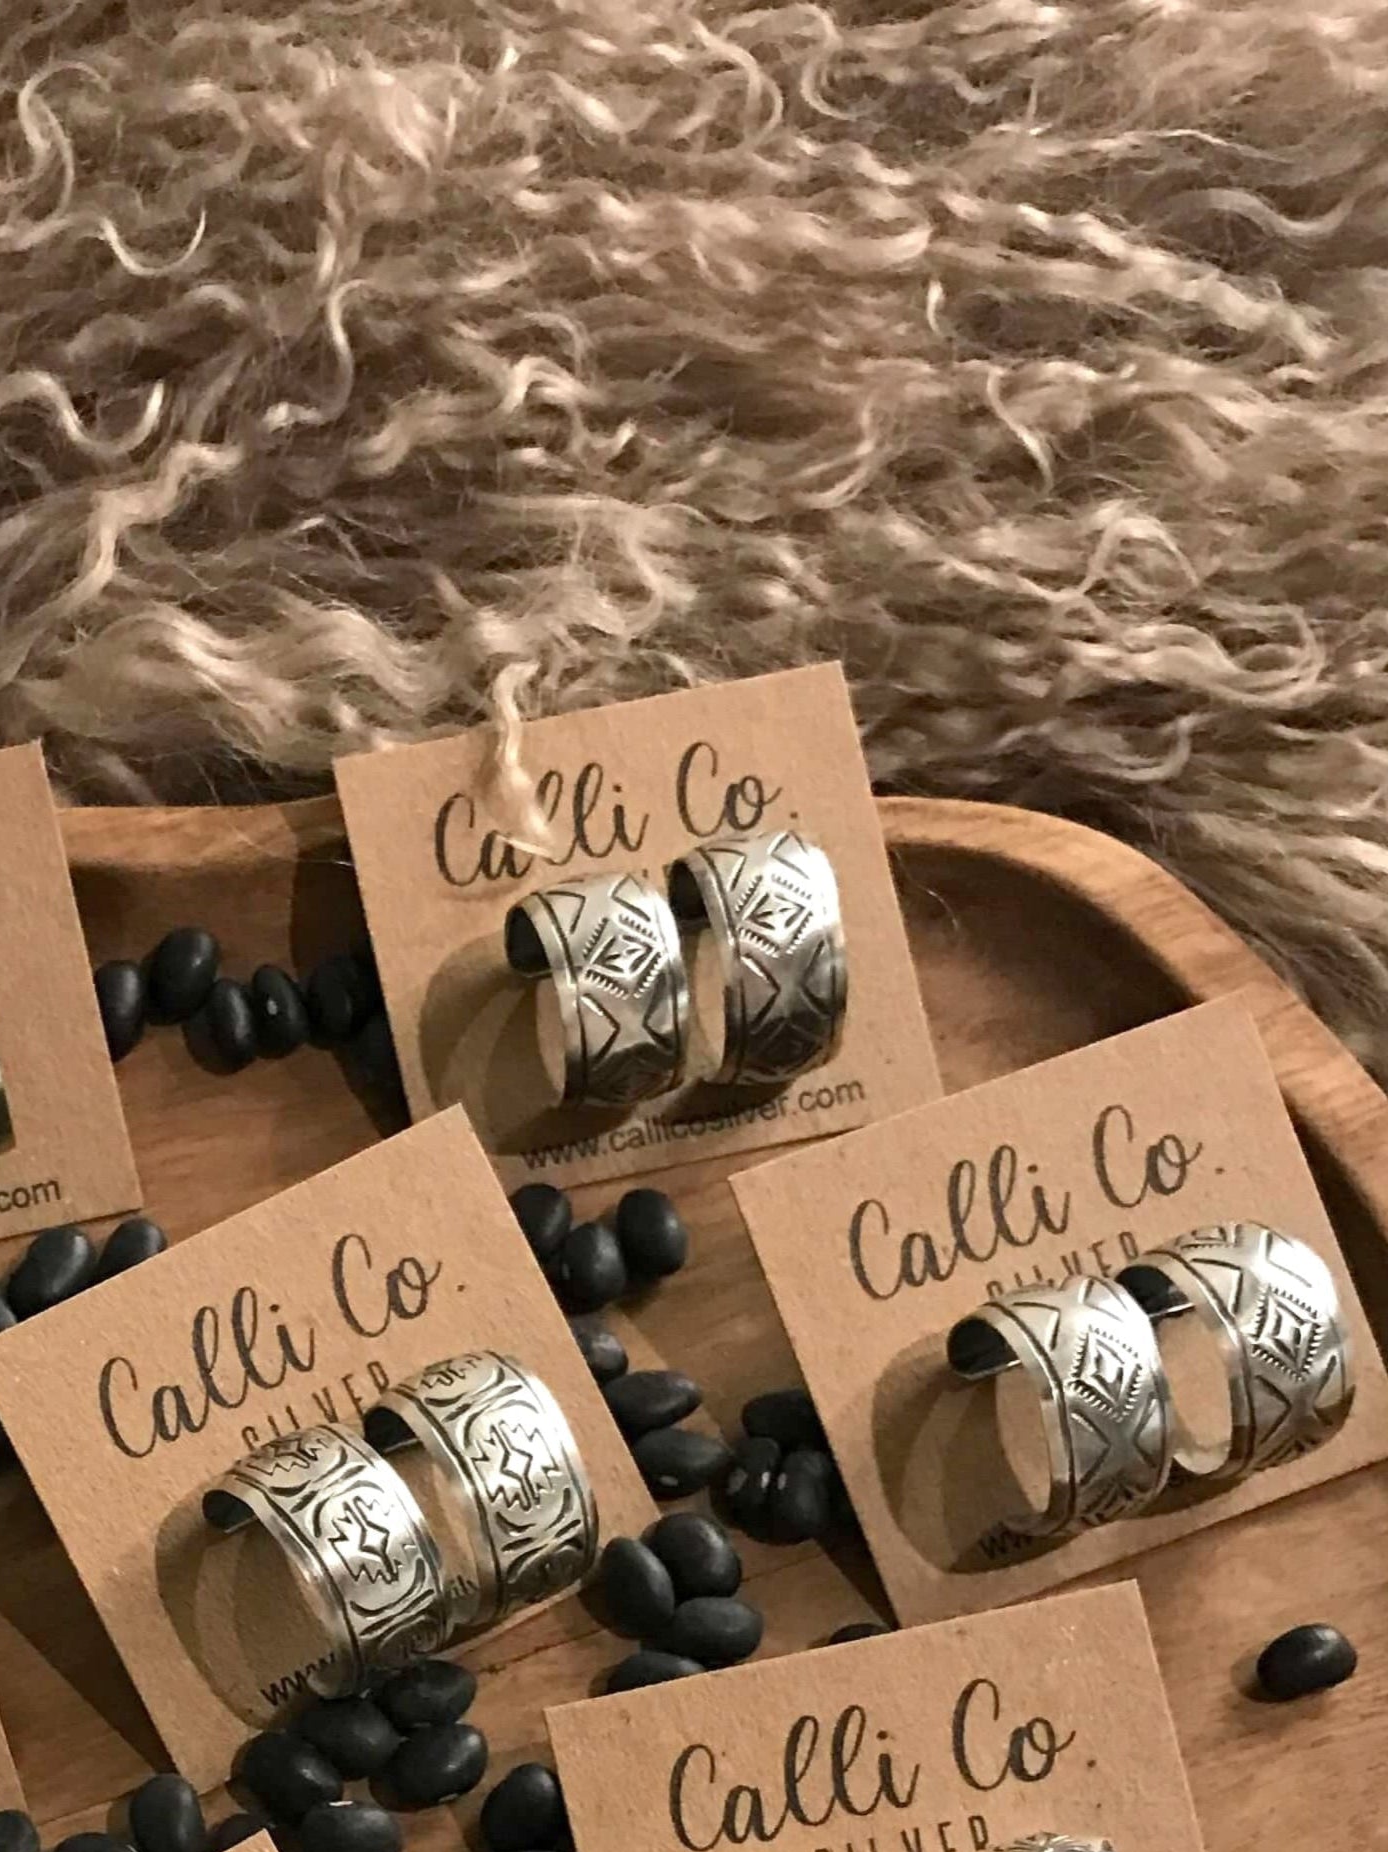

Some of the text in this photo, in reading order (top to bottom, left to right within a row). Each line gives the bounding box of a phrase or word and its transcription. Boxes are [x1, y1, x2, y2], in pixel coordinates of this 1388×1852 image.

[434, 741, 800, 888] Calli Co.
[848, 1104, 1224, 1300] Calli Co.
[99, 1233, 465, 1458] Calli Co.
[668, 1677, 1098, 1852] Calli Co.
